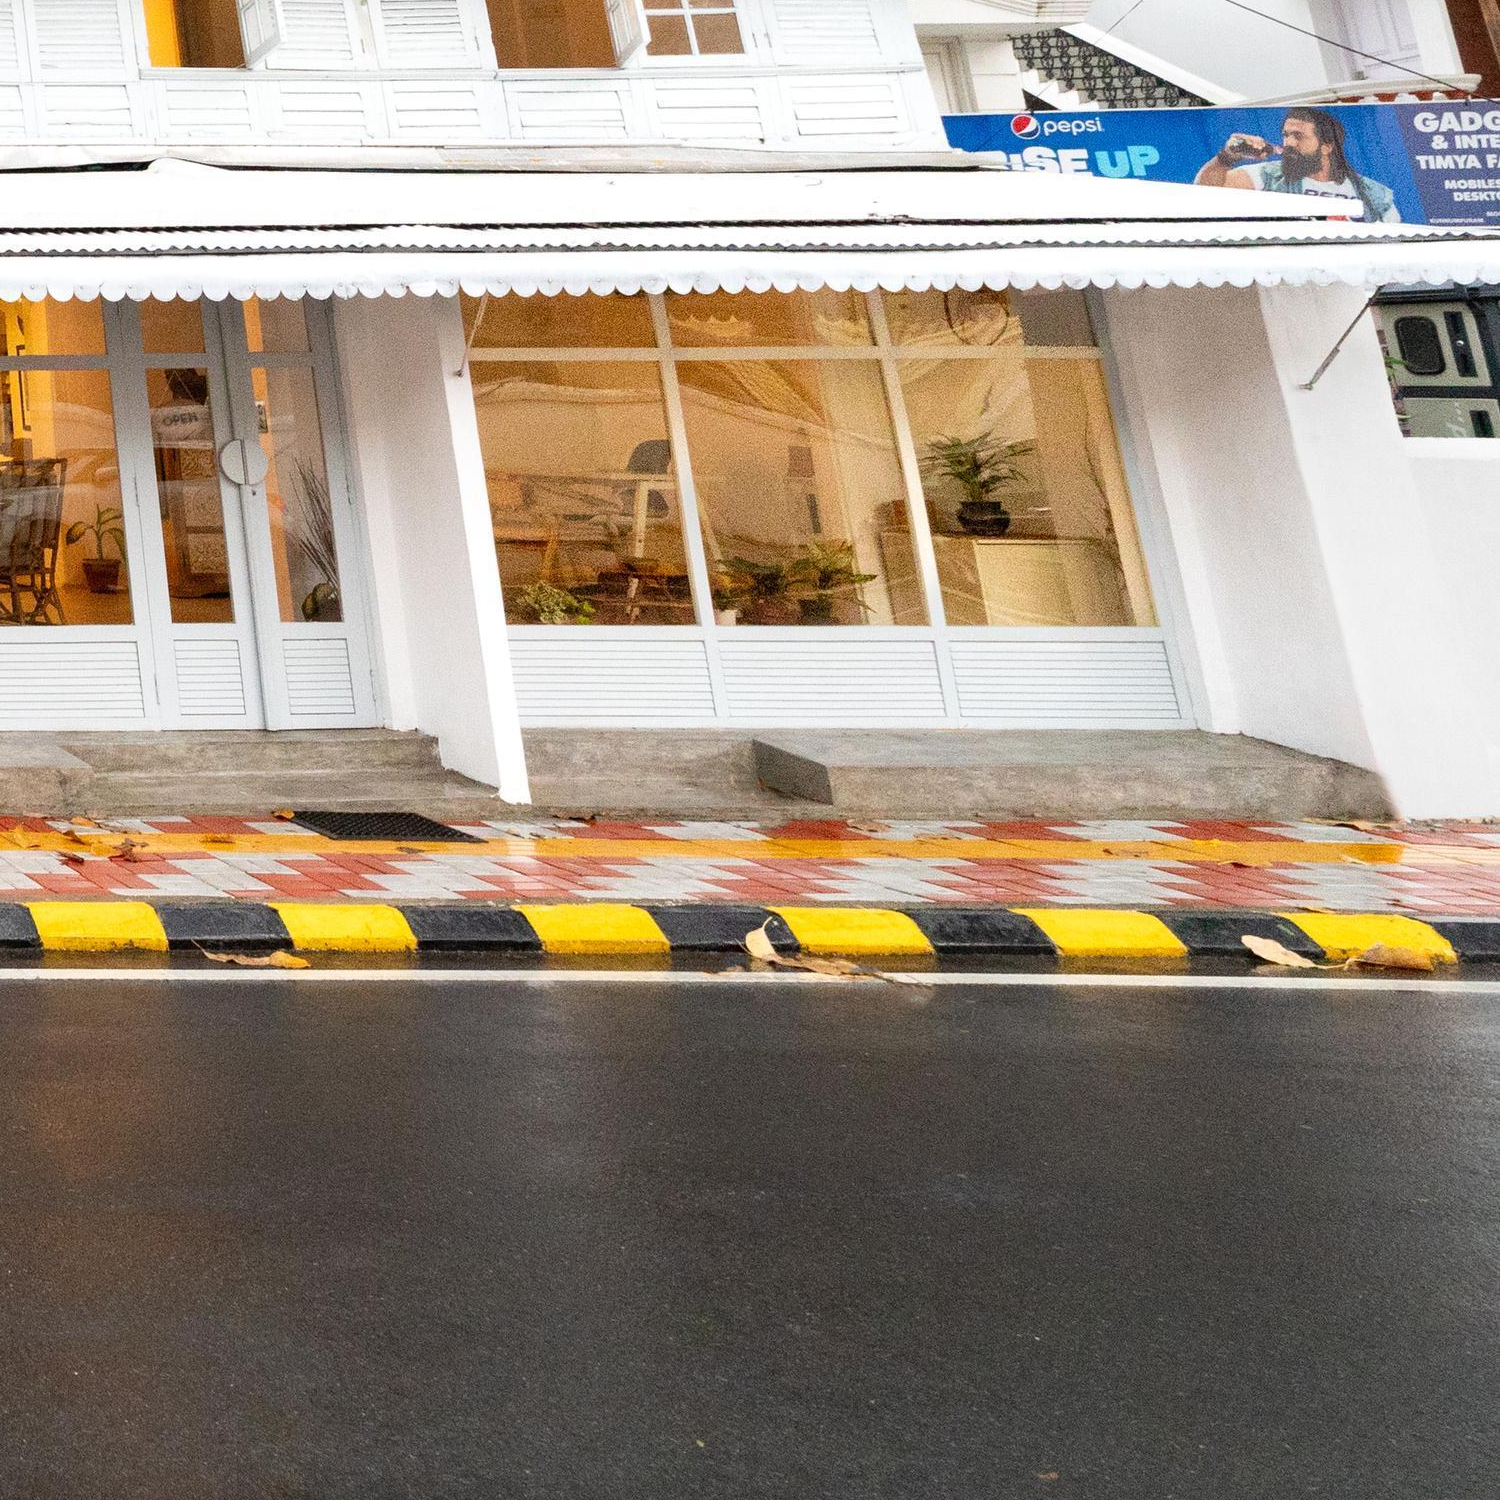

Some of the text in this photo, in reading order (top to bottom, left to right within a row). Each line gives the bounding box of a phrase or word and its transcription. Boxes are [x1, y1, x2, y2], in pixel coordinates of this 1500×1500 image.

[1043, 116, 1103, 136] pepsi
[1431, 134, 1449, 150] &
[1094, 145, 1161, 178] UP
[1415, 153, 1500, 170] TIMYA F
